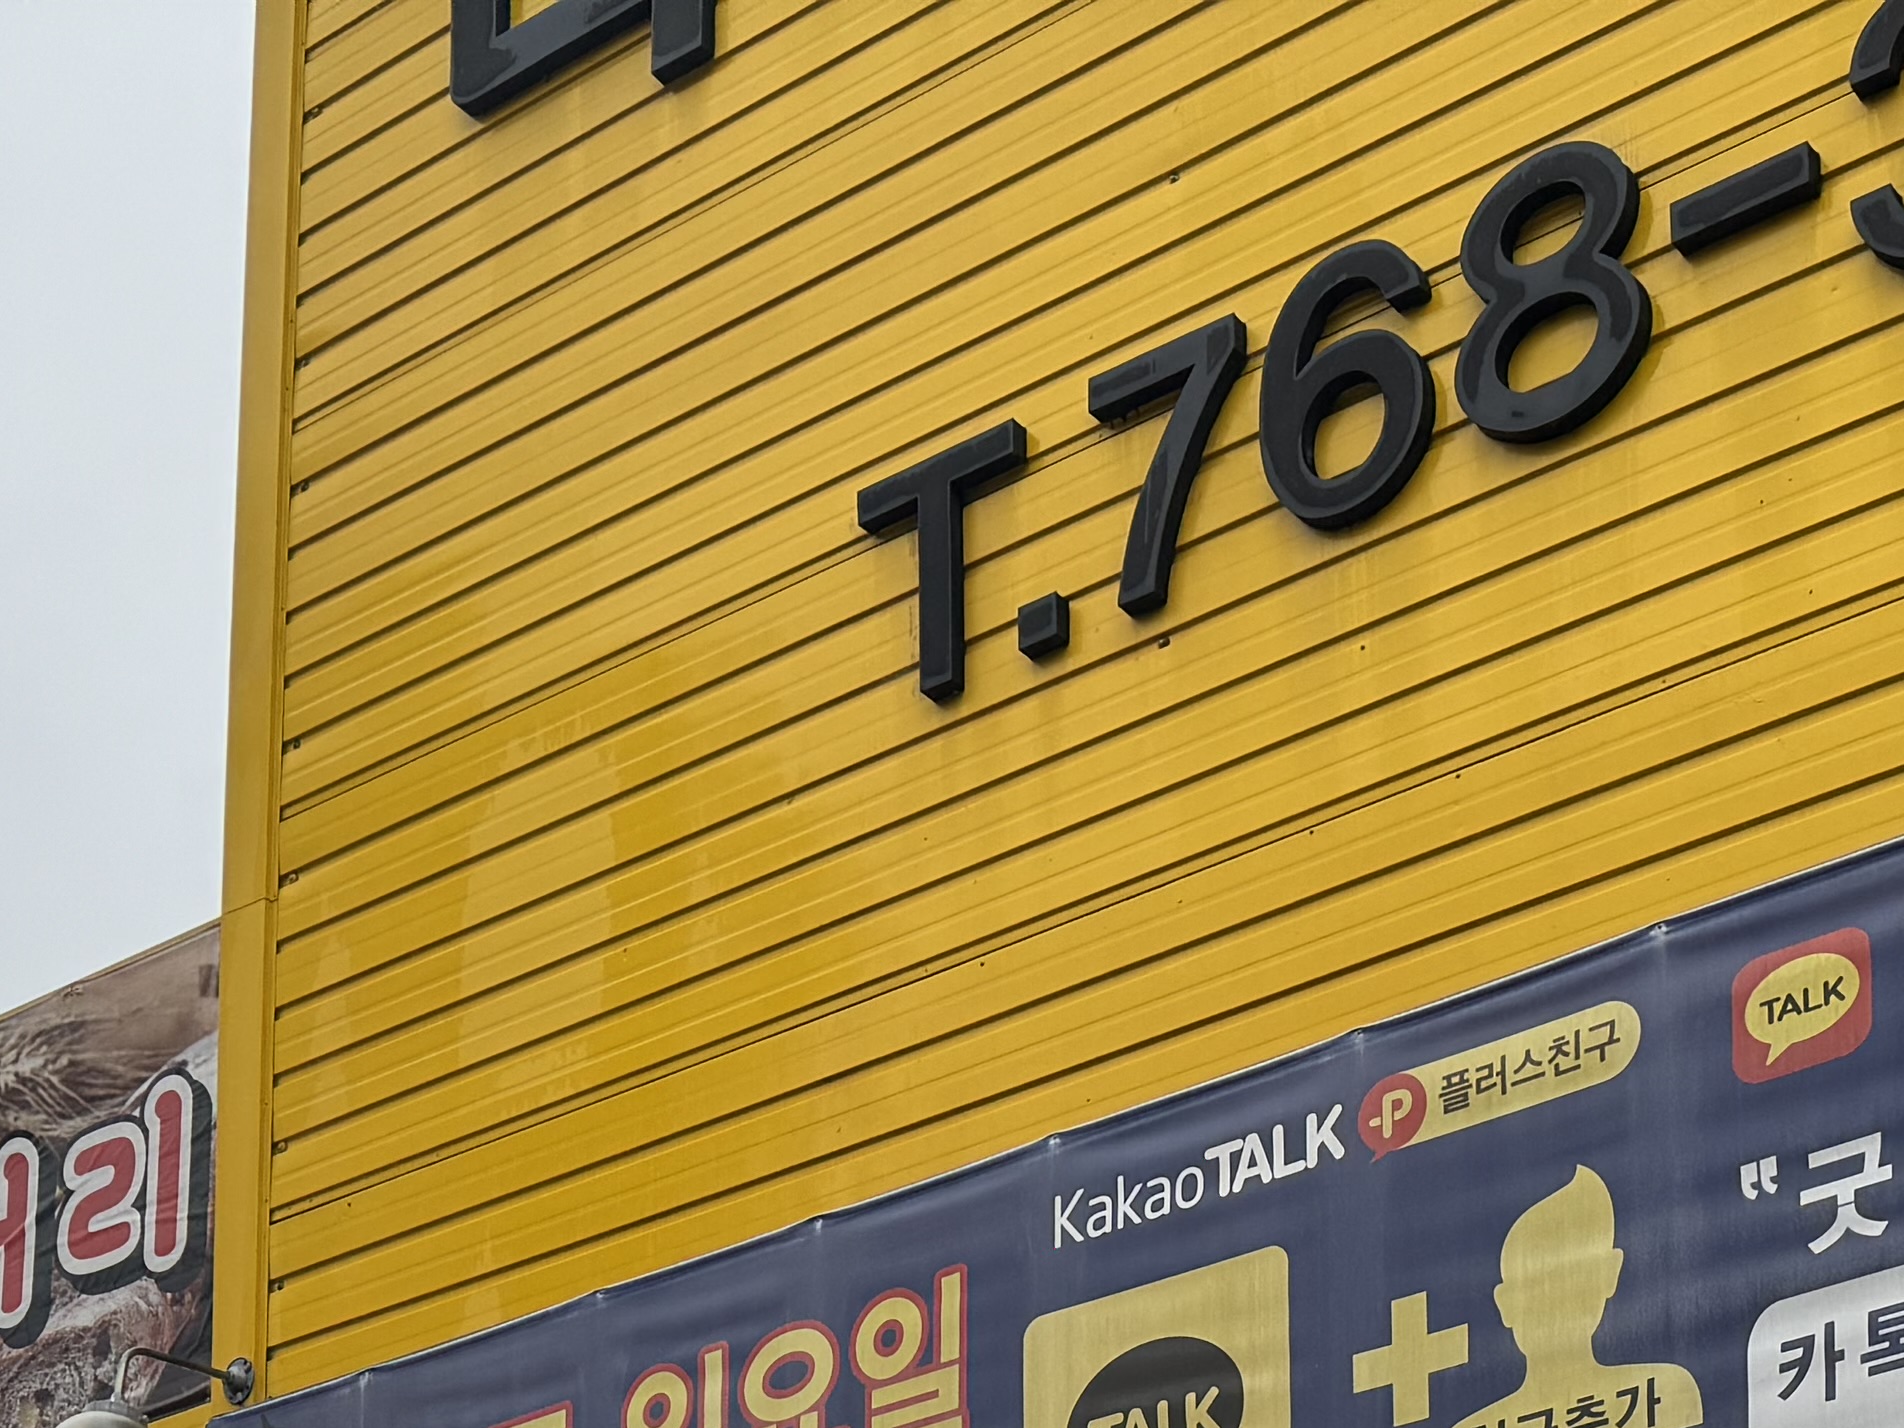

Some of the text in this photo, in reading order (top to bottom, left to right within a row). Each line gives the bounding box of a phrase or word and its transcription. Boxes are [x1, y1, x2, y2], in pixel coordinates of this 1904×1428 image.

[1755, 972, 1849, 1028] TALK
[1438, 1017, 1623, 1116] 플러스친구
[1053, 1103, 1345, 1249] KakaoTALK
